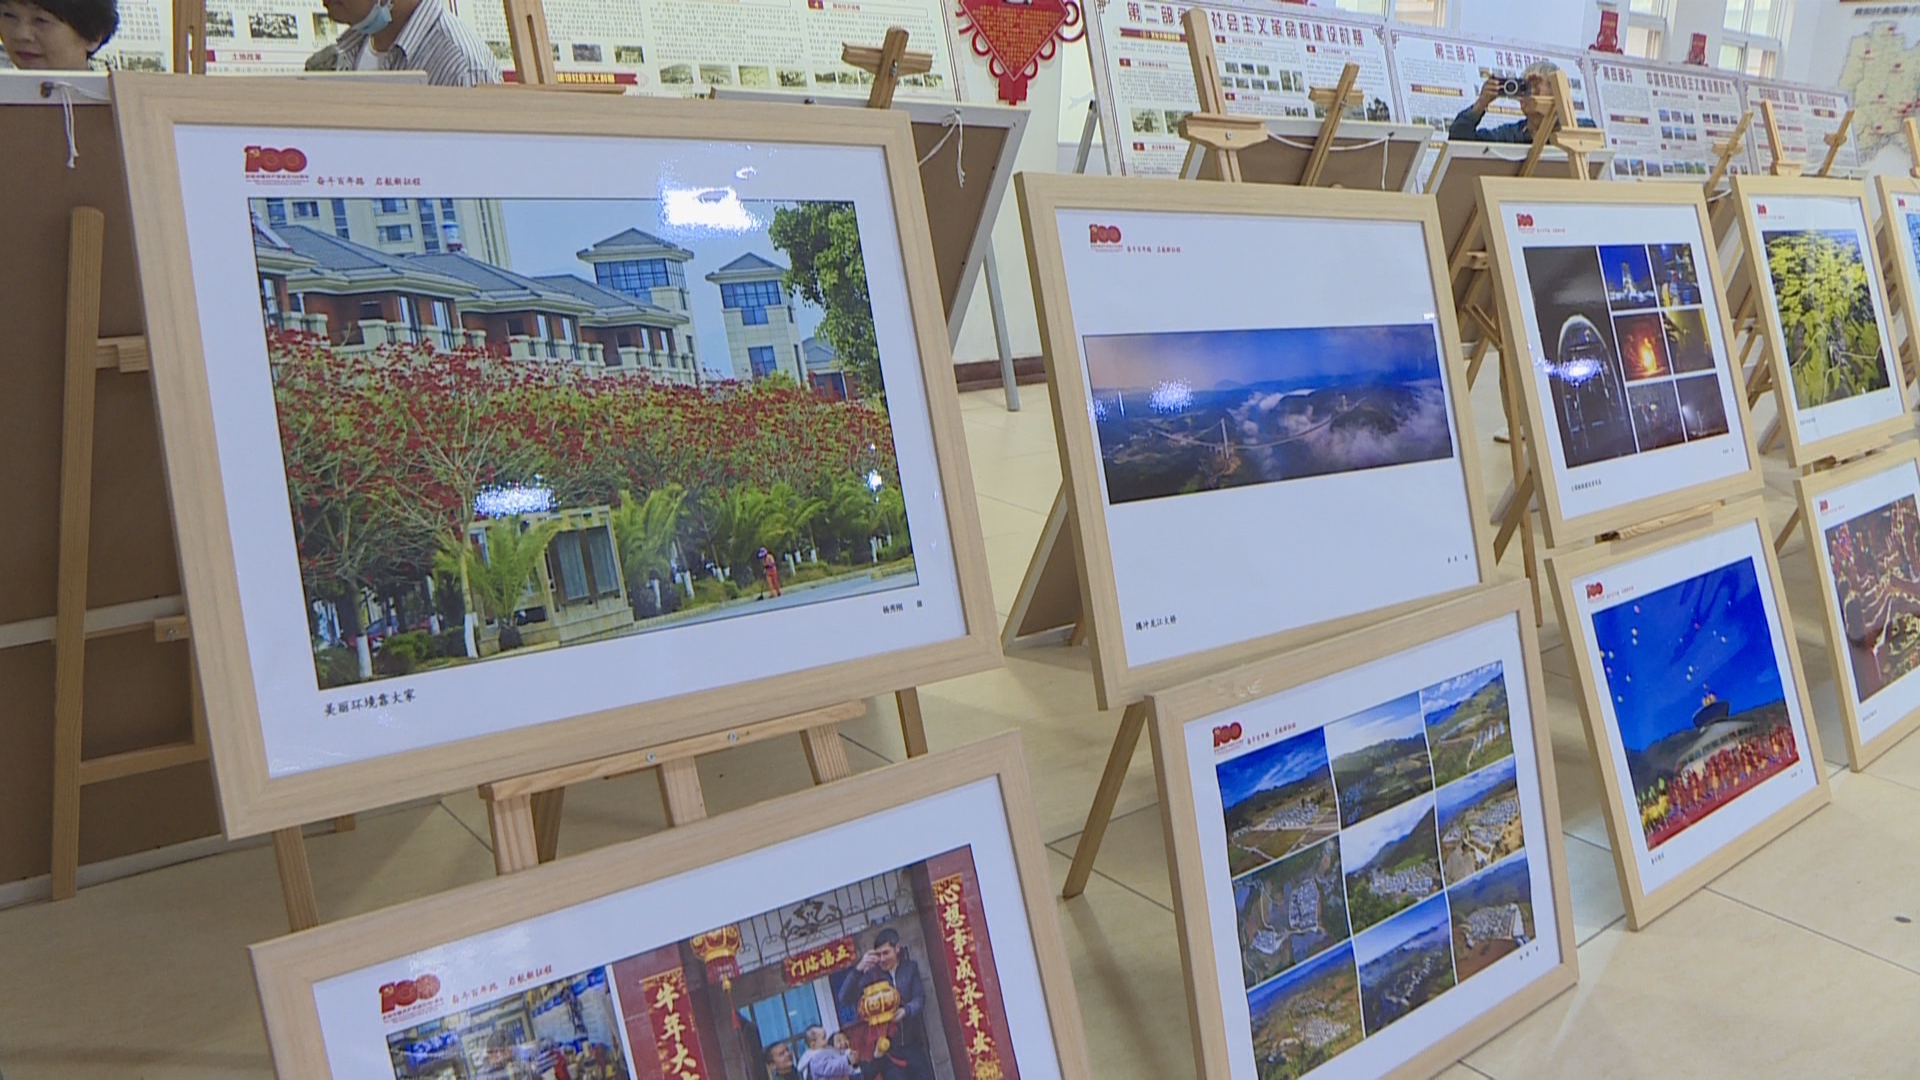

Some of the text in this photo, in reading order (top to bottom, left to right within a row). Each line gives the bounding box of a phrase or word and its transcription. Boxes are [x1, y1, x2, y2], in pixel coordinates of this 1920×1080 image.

[1211, 11, 1364, 47] 社会主义革命和建设时期
[231, 53, 262, 61] 土地改革
[1434, 42, 1476, 64] 第三部分
[244, 146, 307, 173] 100
[317, 175, 365, 186] 奋斗百年路
[375, 177, 422, 186] 启航新征程
[1089, 223, 1122, 243] 100
[324, 688, 416, 717] 美丽环境靠大家
[1212, 722, 1242, 748] 100
[939, 883, 994, 1055] 心想事成永平安
[378, 973, 441, 1014] 100
[451, 964, 553, 1004] 奋斗百年路 启航新征程
